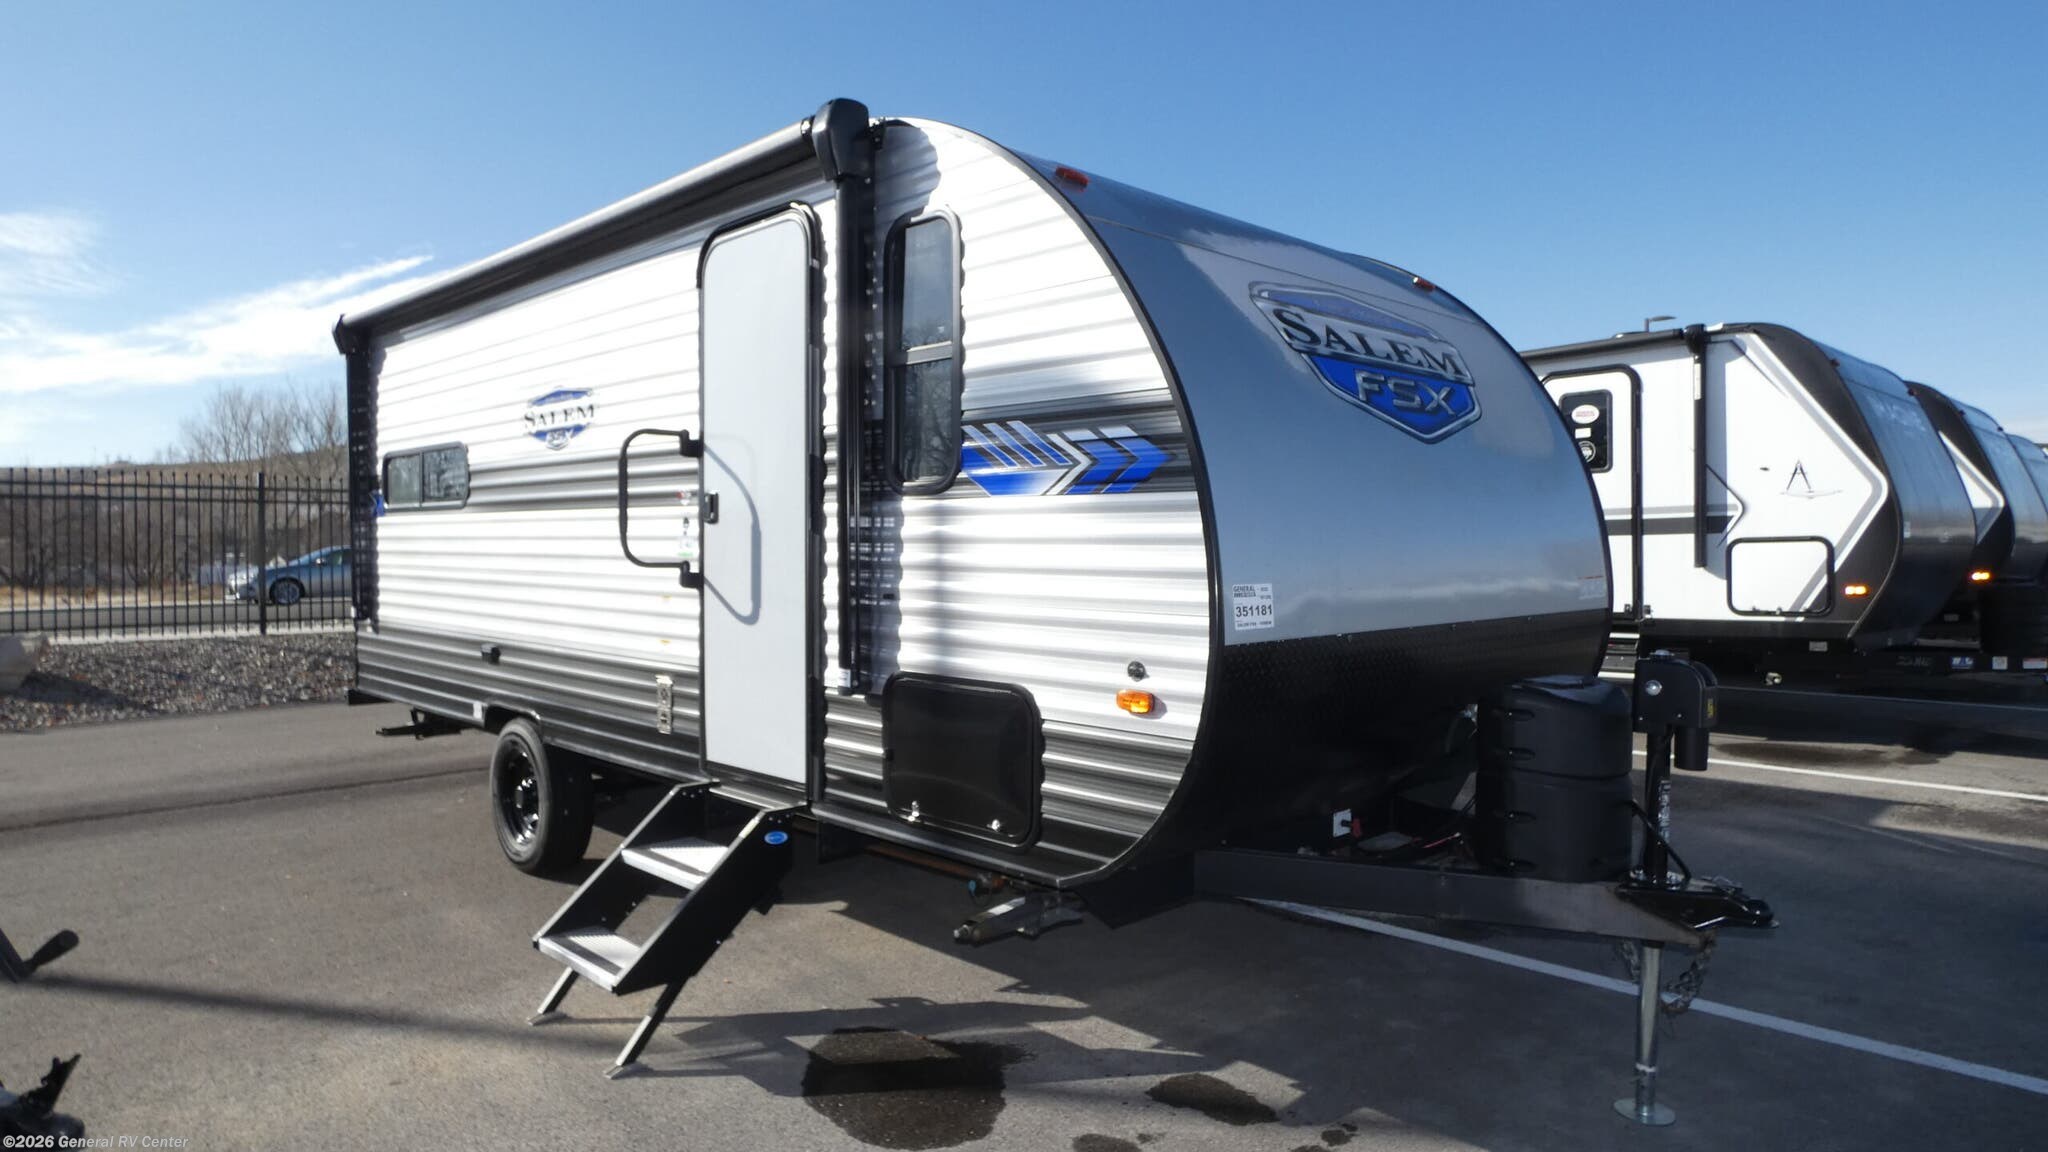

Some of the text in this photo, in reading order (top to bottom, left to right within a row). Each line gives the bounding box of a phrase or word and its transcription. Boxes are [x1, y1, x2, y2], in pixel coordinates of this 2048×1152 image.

[1272, 307, 1470, 378] SALEM
[1354, 369, 1457, 416] FSX
[1235, 604, 1272, 617] 351181
